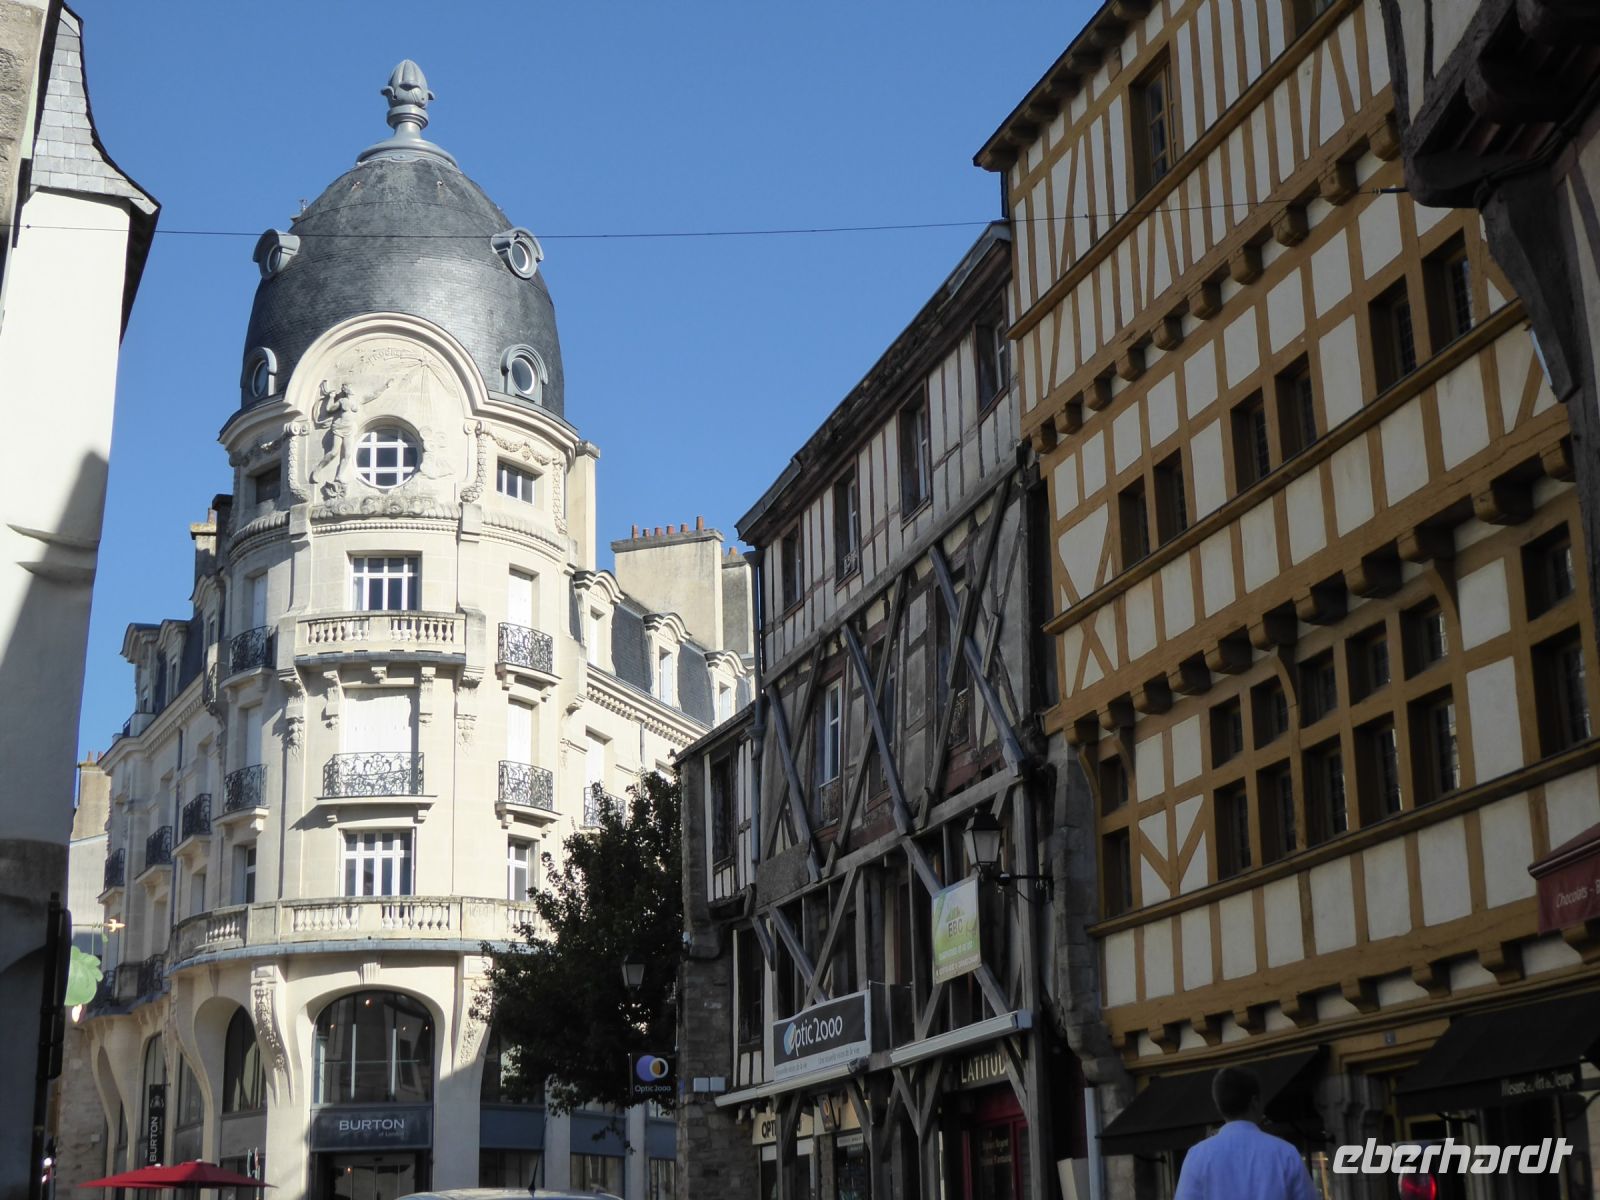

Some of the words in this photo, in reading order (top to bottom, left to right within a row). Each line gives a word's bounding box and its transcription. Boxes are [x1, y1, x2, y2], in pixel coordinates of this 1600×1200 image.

[813, 1015, 843, 1043] 2000
[634, 1084, 653, 1095] Optic
[339, 1118, 405, 1131] BURTON
[150, 1116, 160, 1163] BURTON
